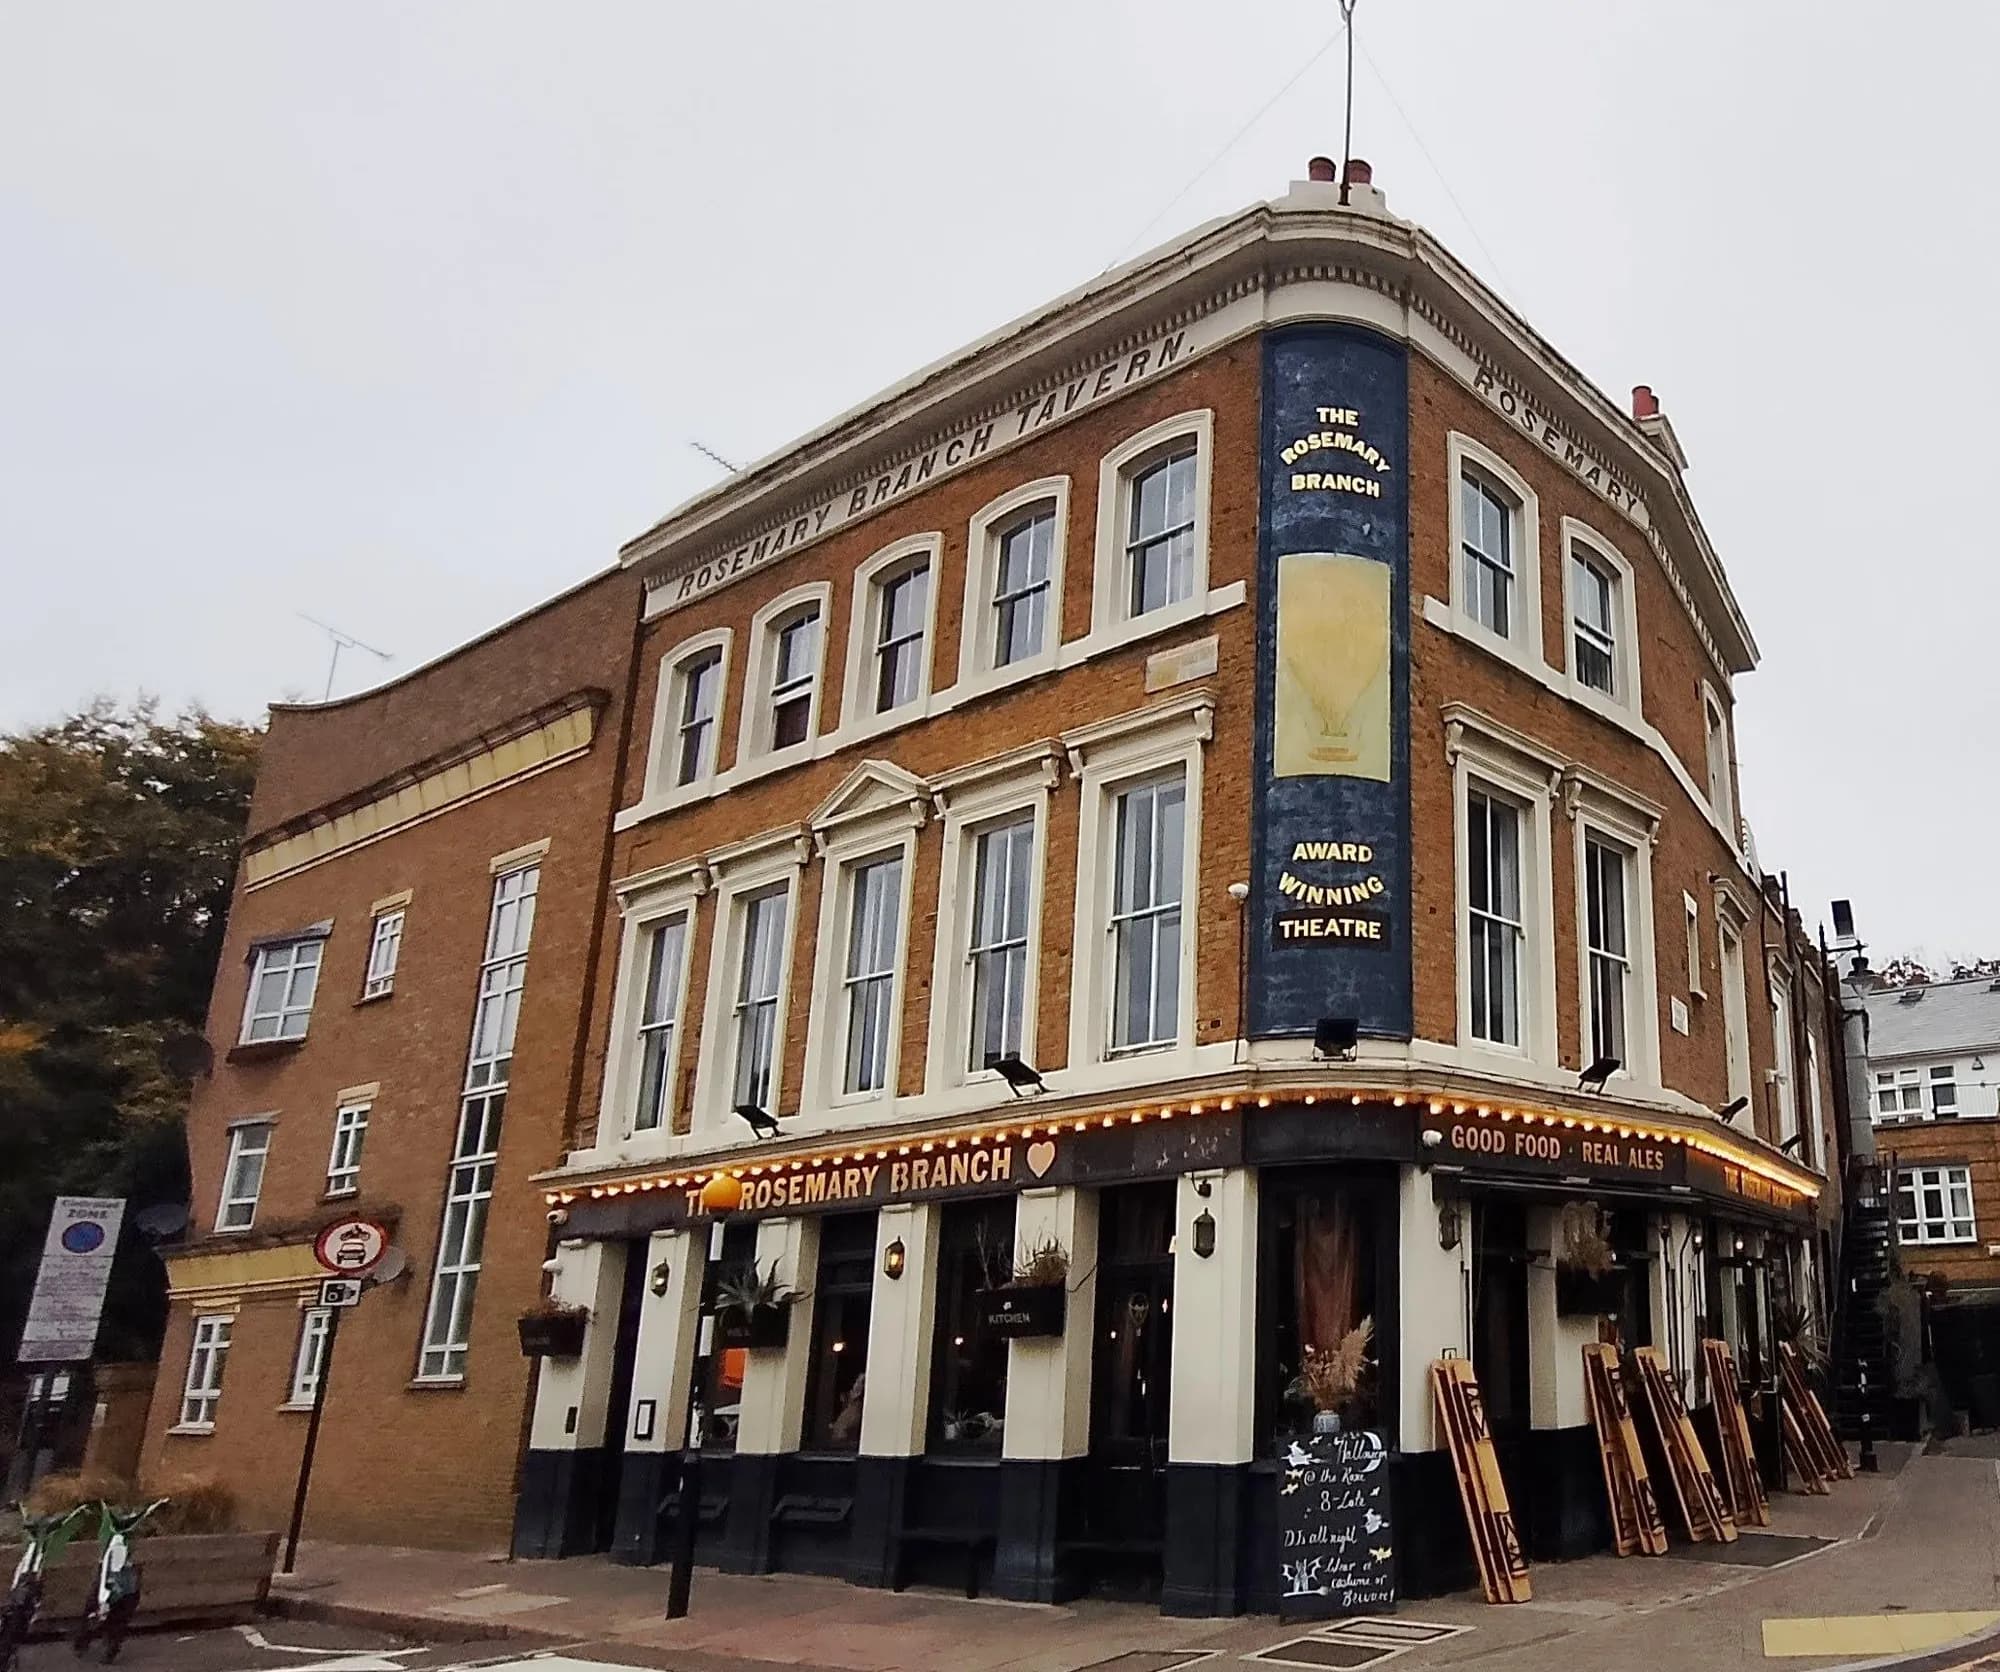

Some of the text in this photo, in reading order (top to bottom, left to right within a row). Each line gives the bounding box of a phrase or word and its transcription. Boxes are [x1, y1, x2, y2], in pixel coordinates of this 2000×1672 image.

[1316, 407, 1358, 426] THE
[1280, 431, 1391, 472] ROSEMARY
[1473, 366, 1637, 513] ROSEMARY
[677, 331, 1196, 601] ROSEMARY BRANCH TAVERN.
[1291, 473, 1380, 498] BRANCH
[1292, 842, 1372, 863] AWARD
[1278, 871, 1384, 906] WINNING
[1279, 918, 1381, 940] THEATRE
[1451, 1125, 1664, 1171] GOOD FOOD REAL ALES
[739, 1165, 879, 1210] ROSEMARY
[890, 1147, 1012, 1194] BRANCH
[67, 1209, 107, 1219] ZONE
[988, 1312, 1031, 1324] KITCHEN
[1304, 1470, 1316, 1486] @
[1309, 1525, 1327, 1544] all
[1330, 1525, 1357, 1553] night
